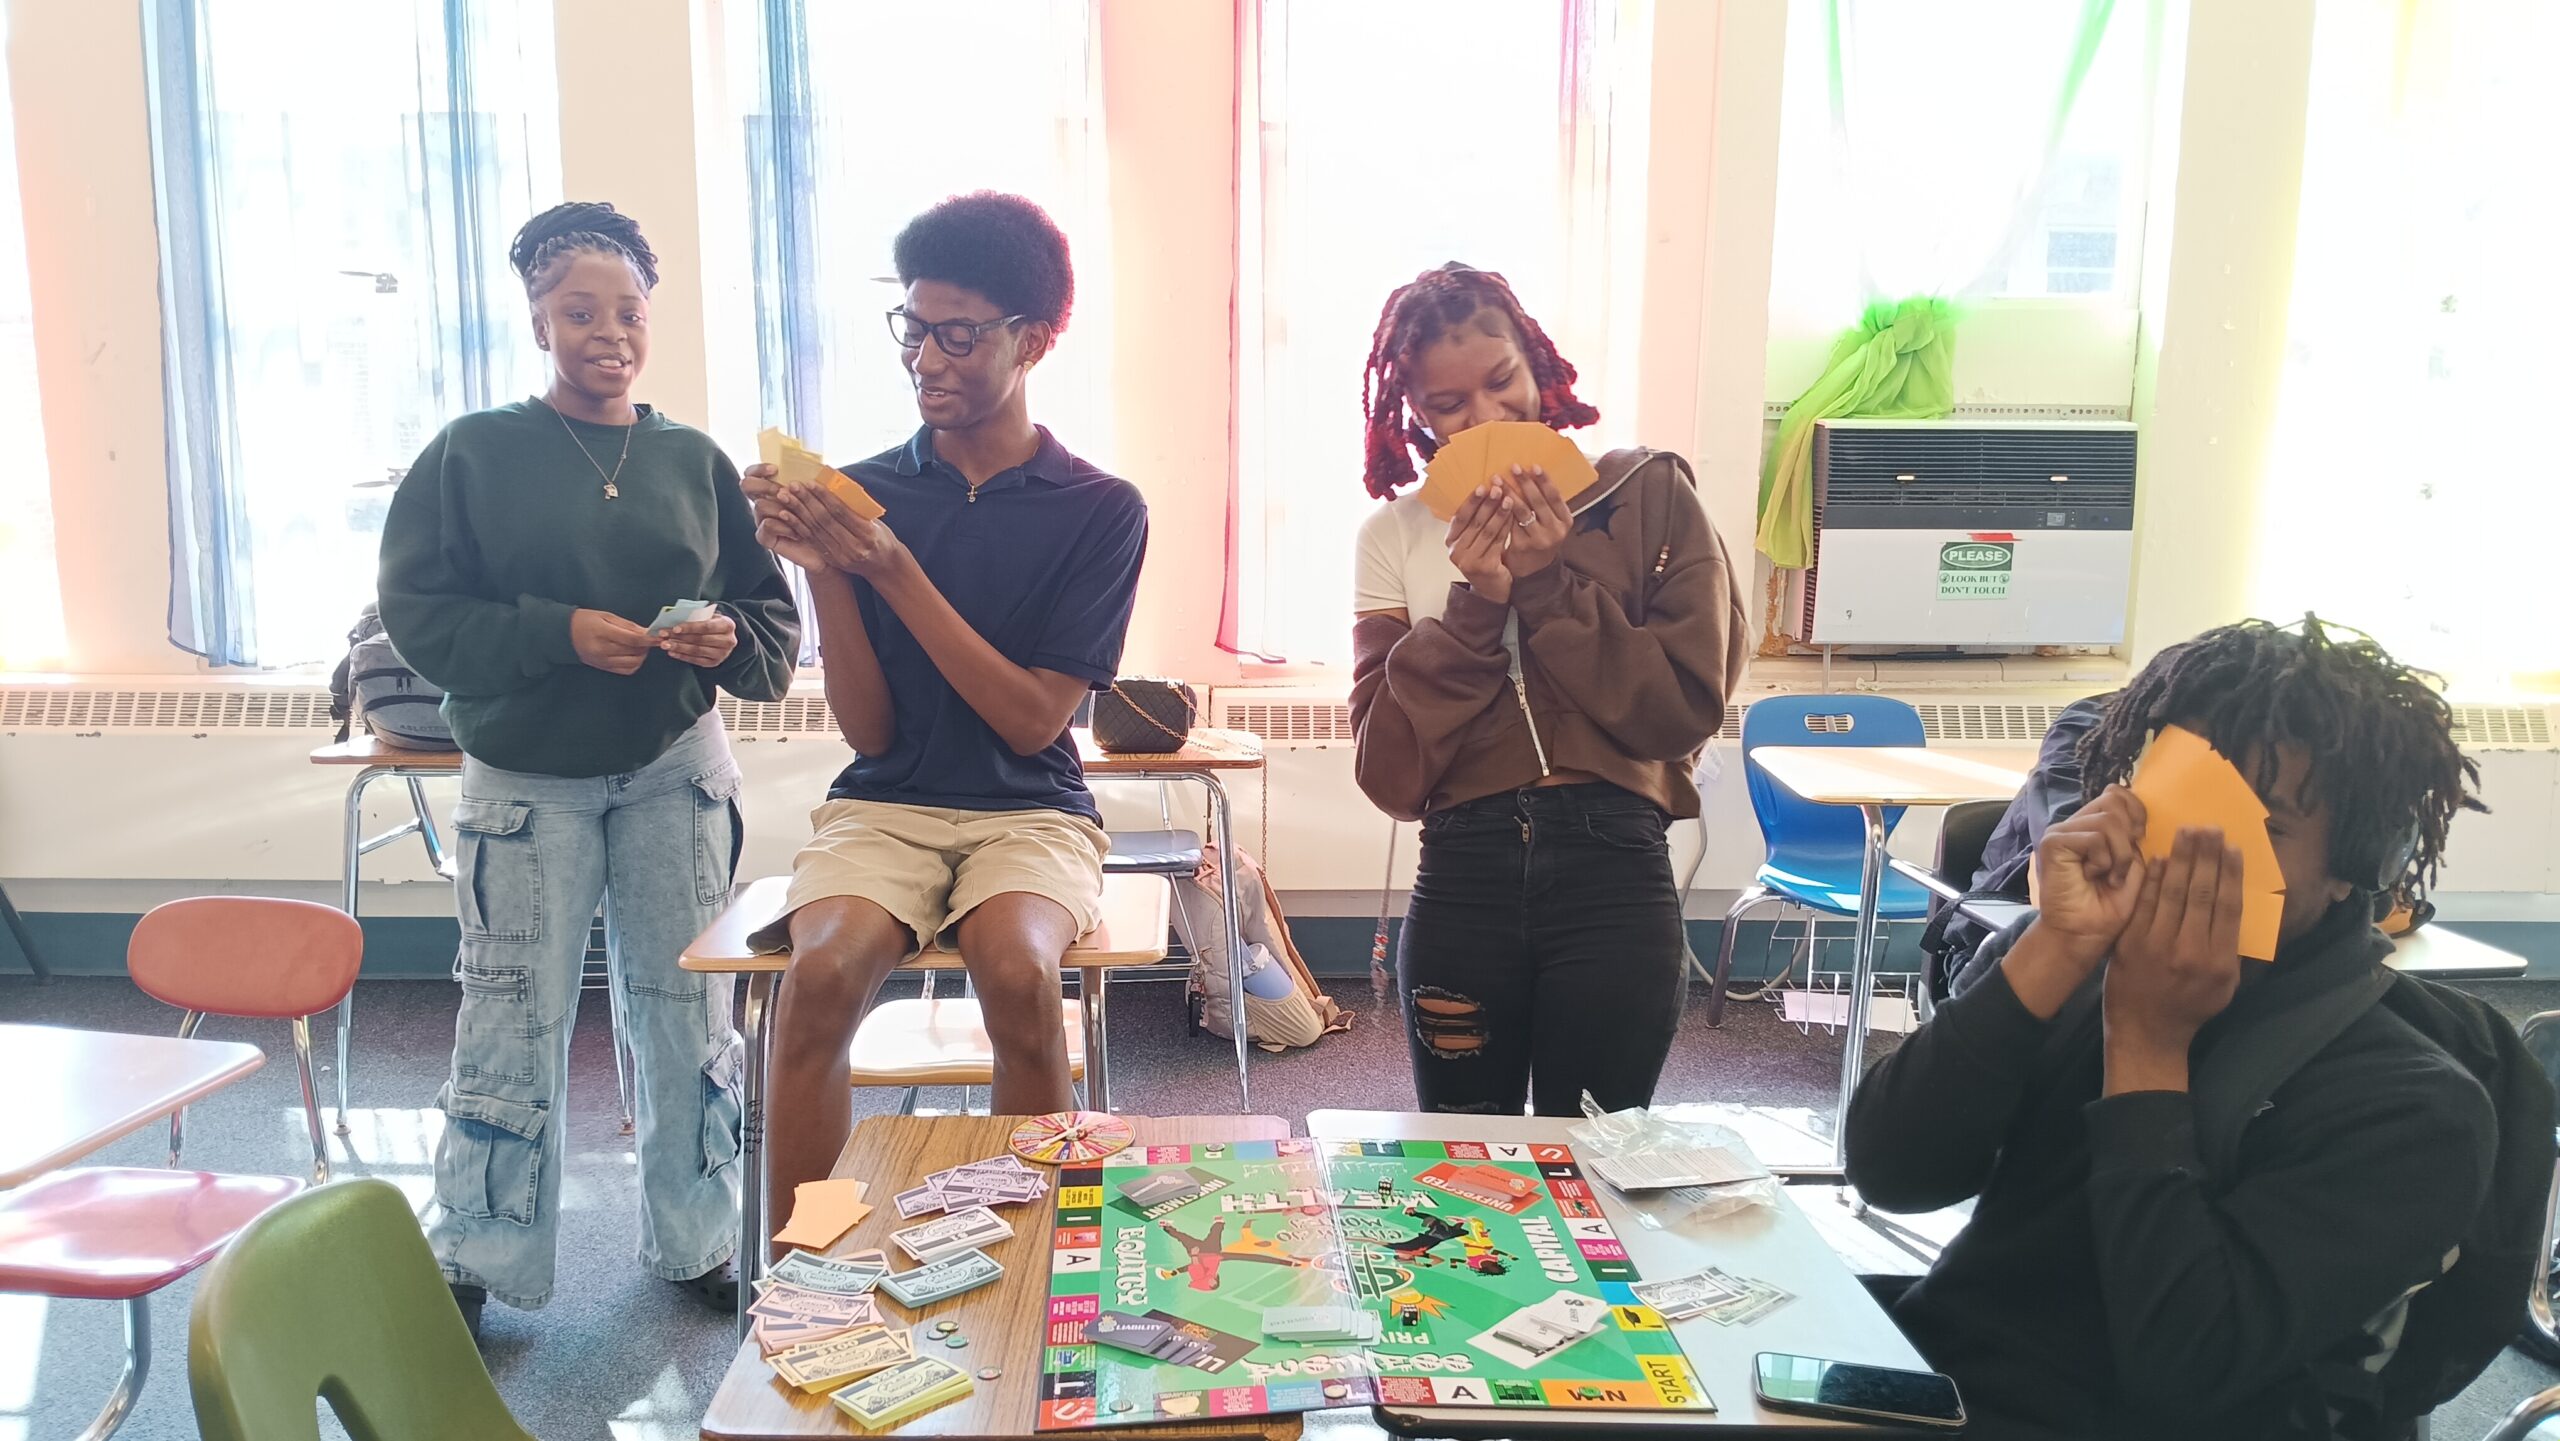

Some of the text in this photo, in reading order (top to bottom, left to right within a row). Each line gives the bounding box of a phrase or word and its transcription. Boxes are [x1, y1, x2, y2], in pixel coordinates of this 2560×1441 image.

[1949, 551, 2003, 561] PLEASE
[1941, 586, 2005, 594] DON'T TOUCH
[1498, 1146, 1518, 1157] A
[1540, 1148, 1563, 1159] U
[1548, 1168, 1572, 1177] L
[1143, 1179, 1227, 1220] INVSTMENT
[1221, 1188, 1440, 1212] WEALTH
[1581, 1224, 1606, 1234] A
[1518, 1216, 1579, 1282] CAPITAL
[1067, 1254, 1091, 1266] A
[1113, 1225, 1147, 1305] EQUITY
[823, 1262, 852, 1272] $10
[920, 1263, 949, 1275] $10
[1647, 1361, 1687, 1404] START
[1452, 1385, 1478, 1400] A
[1055, 1401, 1088, 1420] U
